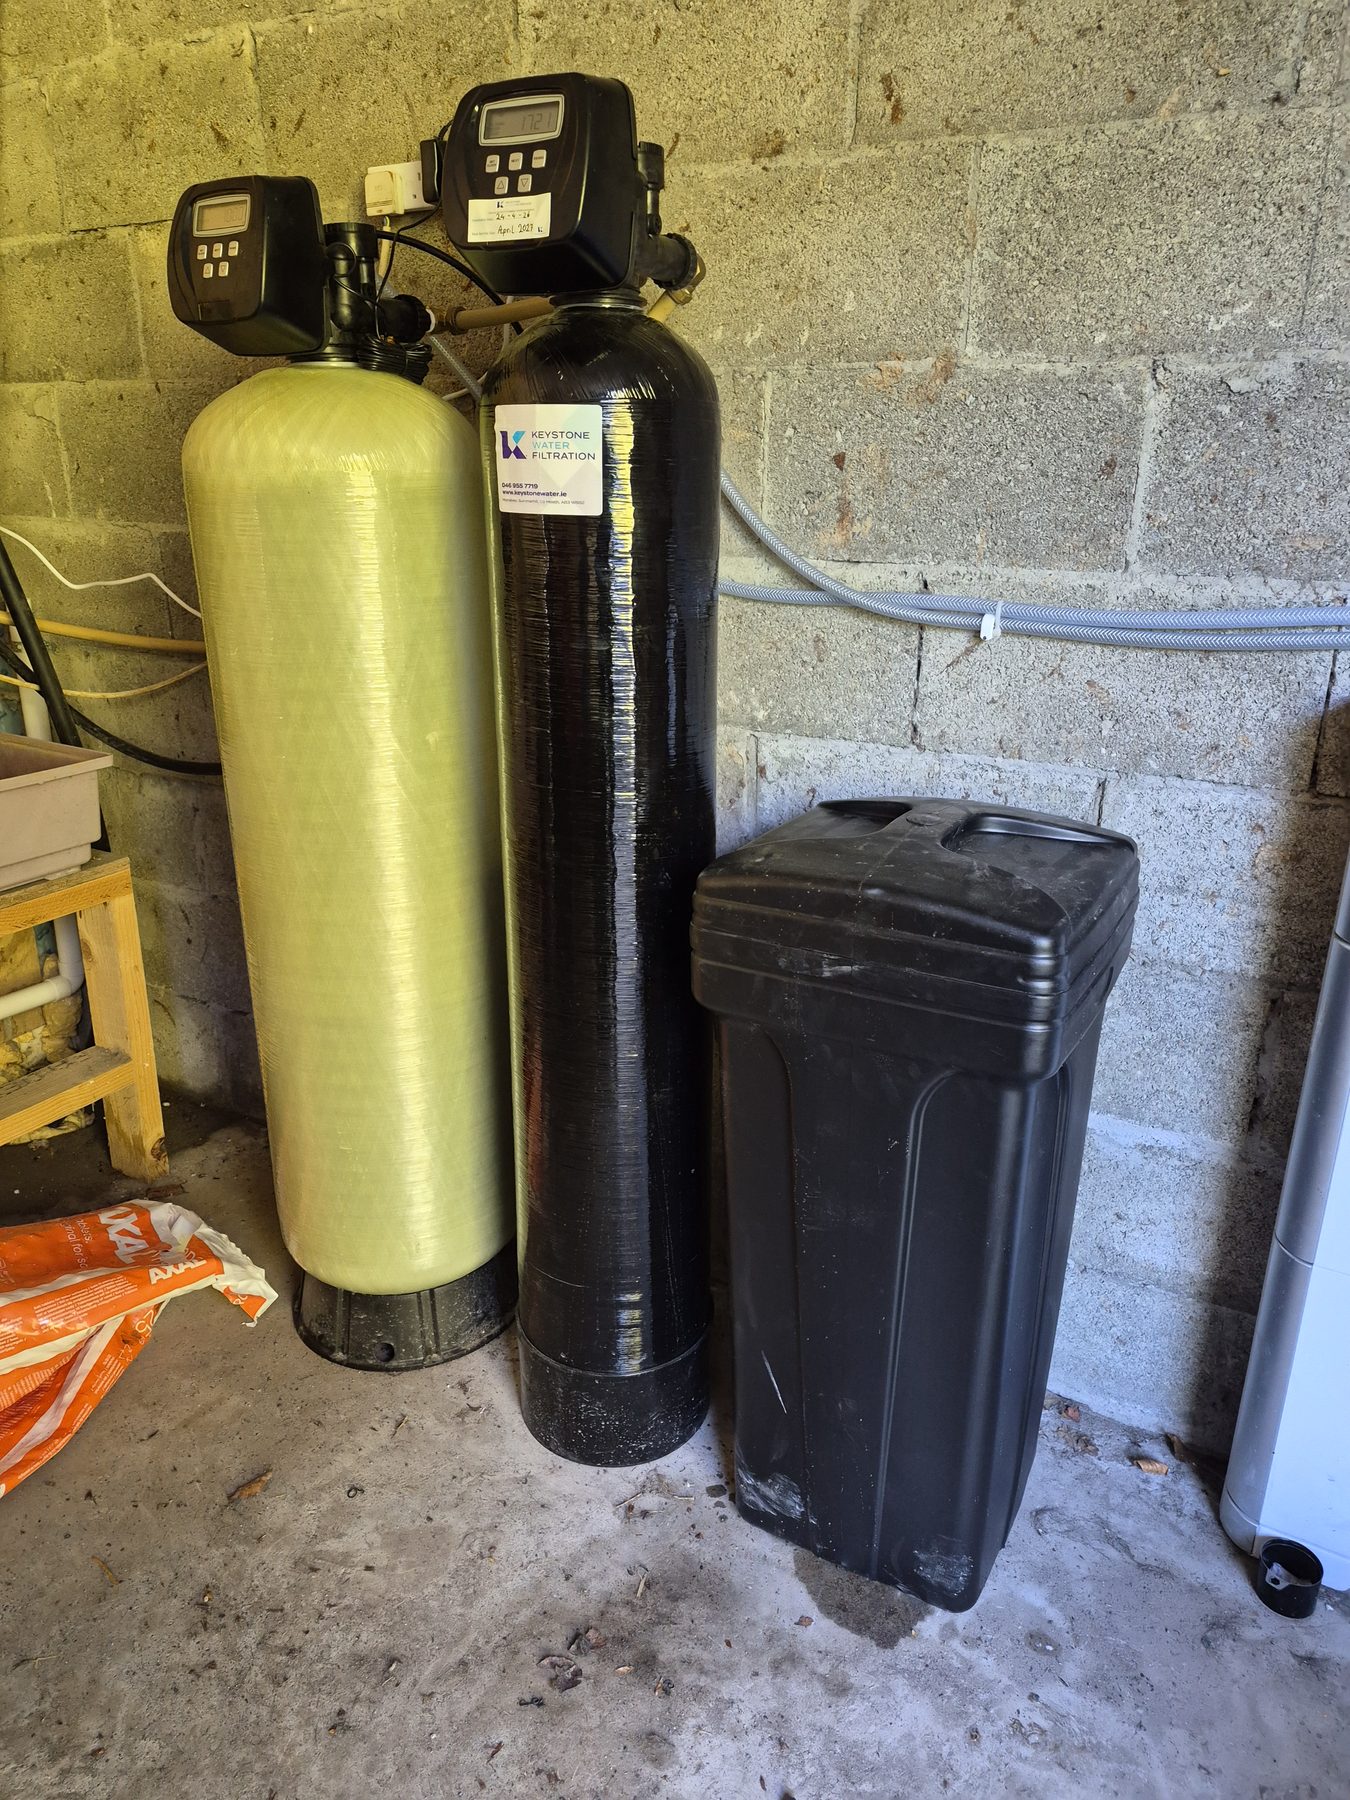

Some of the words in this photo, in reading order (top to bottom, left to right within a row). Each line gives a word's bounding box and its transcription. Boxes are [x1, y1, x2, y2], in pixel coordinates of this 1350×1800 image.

[531, 431, 590, 440] KEYSTONE
[532, 442, 570, 450] WATER
[532, 451, 596, 461] FILTRATION
